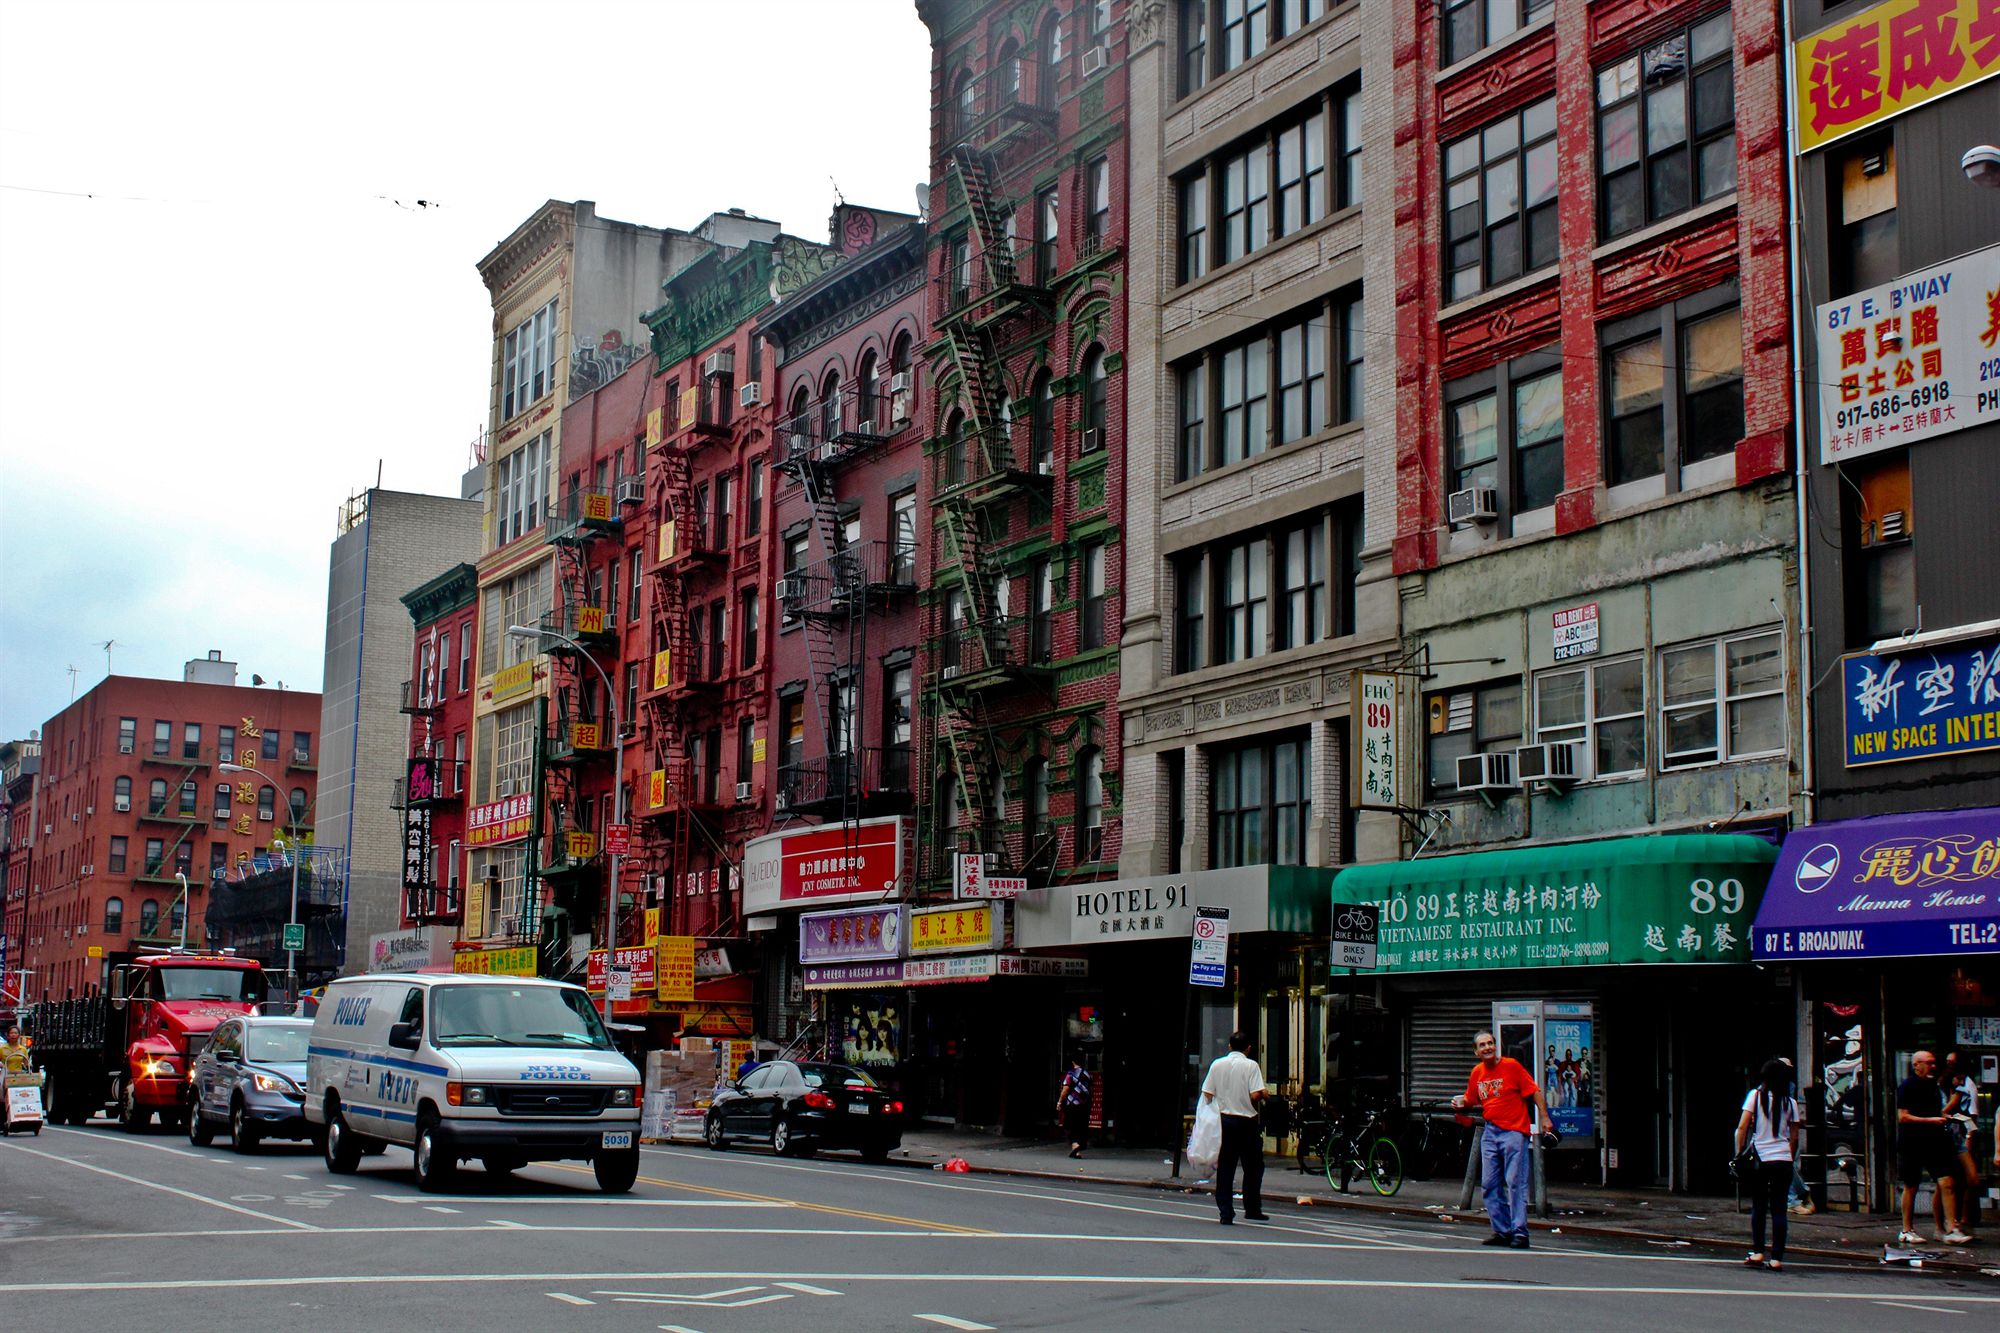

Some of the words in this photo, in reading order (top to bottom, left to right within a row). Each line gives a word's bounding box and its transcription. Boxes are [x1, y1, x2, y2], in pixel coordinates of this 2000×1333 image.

[1828, 306, 1851, 329] 87
[1861, 298, 1880, 319] E.
[1891, 272, 1952, 310] B'WAY
[1841, 348, 1943, 404] 巴士公司
[1837, 380, 1950, 429] 917-686-6918
[1902, 404, 1957, 433] 亞特蘭大
[586, 496, 607, 518] 福
[580, 608, 602, 632] 州
[1554, 612, 1568, 627] FOR
[1568, 608, 1583, 624] RENT
[1565, 626, 1580, 641] ABC
[1367, 702, 1391, 729] 89
[575, 727, 597, 749] 超
[1854, 731, 1887, 755] NEW
[1892, 723, 1937, 751] SPACE
[1365, 737, 1378, 795] 越南
[1381, 732, 1394, 803] 牛肉河粉
[571, 835, 591, 855] 市
[817, 876, 846, 891] COSMETIC
[1077, 886, 1158, 917] HOTEL
[1166, 882, 1189, 907] 91
[1416, 893, 1440, 921] 89
[1444, 882, 1602, 918] 正宗越南牛肉河粉
[1690, 878, 1745, 914] 89
[1838, 895, 1911, 912] Manna
[1923, 889, 1986, 908] House
[920, 910, 984, 938] 閩江餐館
[1100, 915, 1165, 934] 金匯大酒店
[1380, 924, 1453, 944] VIETNAMESE
[1460, 919, 1543, 939] RESTAURANT
[1550, 917, 1577, 934] INC.
[1335, 930, 1352, 940] BIKE
[1354, 933, 1375, 942] LANE
[1644, 922, 1754, 952] 越南餐
[1765, 933, 1778, 952] 87
[1783, 932, 1793, 951] E.
[1799, 930, 1864, 950] BROADWAY.
[1343, 945, 1366, 955] BIKES
[1343, 955, 1364, 964] ONLY
[1000, 958, 1062, 974] 福州閩江小吃
[333, 997, 371, 1025] POLICE
[1556, 1025, 1580, 1036] GUYS
[378, 1070, 410, 1104] NYPD
[520, 1072, 591, 1080] POLICE
[604, 1134, 629, 1147] 5030
